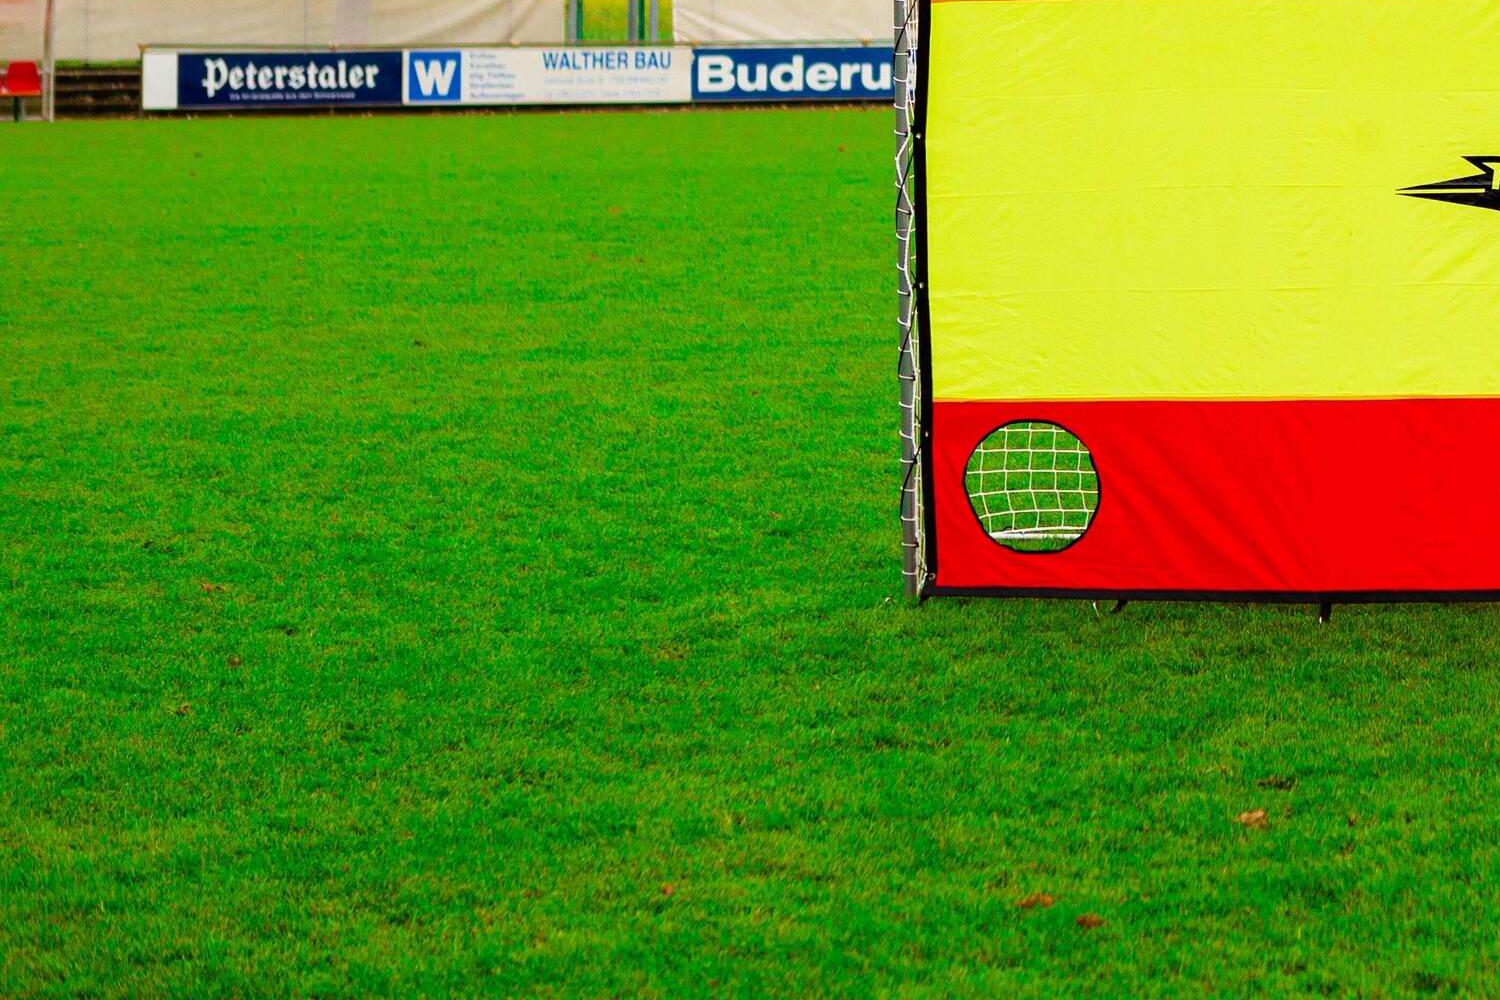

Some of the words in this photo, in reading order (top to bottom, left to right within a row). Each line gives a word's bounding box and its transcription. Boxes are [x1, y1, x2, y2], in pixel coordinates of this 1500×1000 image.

[202, 57, 379, 98] Peterstaler
[413, 60, 457, 96] W
[542, 51, 629, 70] WALTHER
[634, 51, 672, 69] BAU
[697, 54, 892, 93] Buderu
